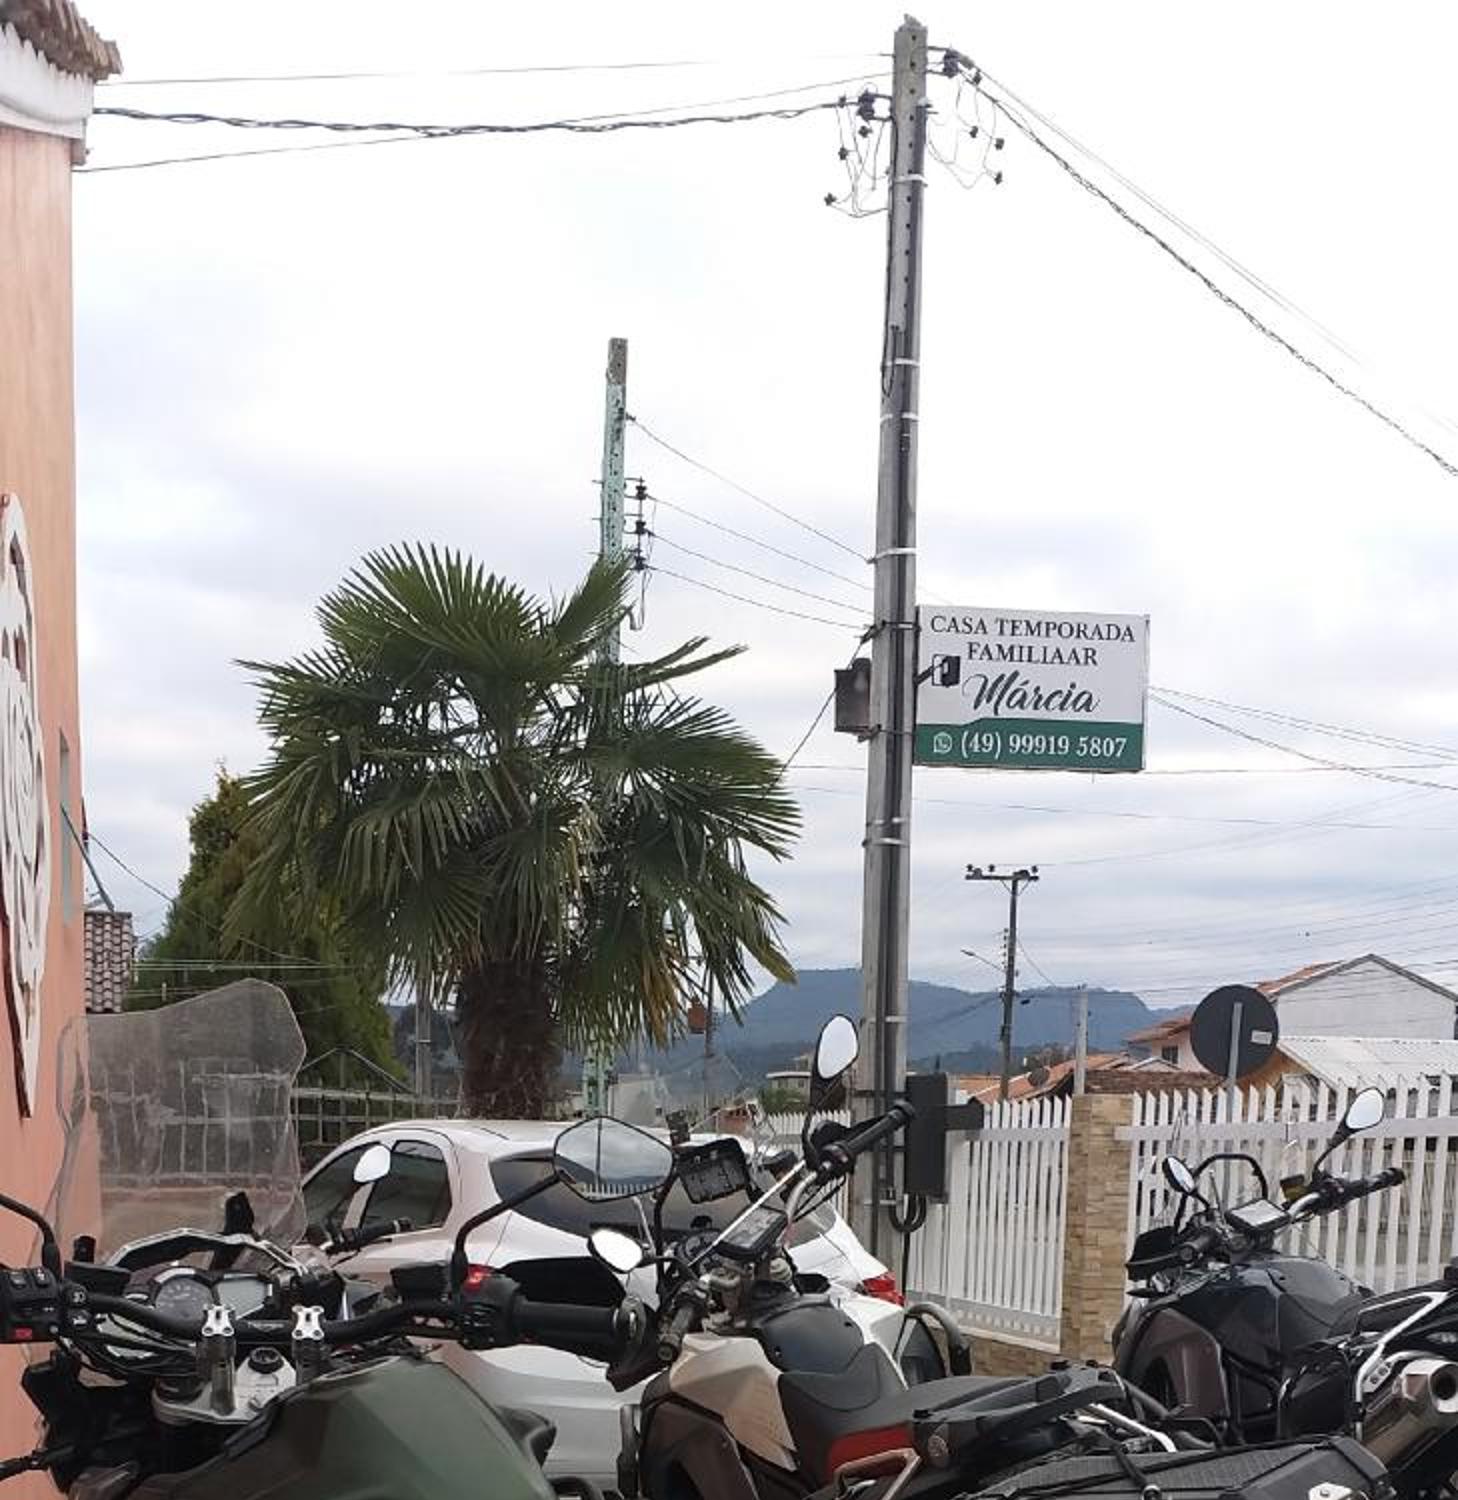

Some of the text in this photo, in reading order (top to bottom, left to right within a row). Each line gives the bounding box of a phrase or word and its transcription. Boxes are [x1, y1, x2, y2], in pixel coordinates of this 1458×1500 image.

[931, 615, 1136, 643] CASA TEMPORADA
[966, 641, 1099, 667] FAMILIAAR
[961, 670, 1100, 716] Márcia
[961, 731, 1127, 759] (49) 99919 5807
